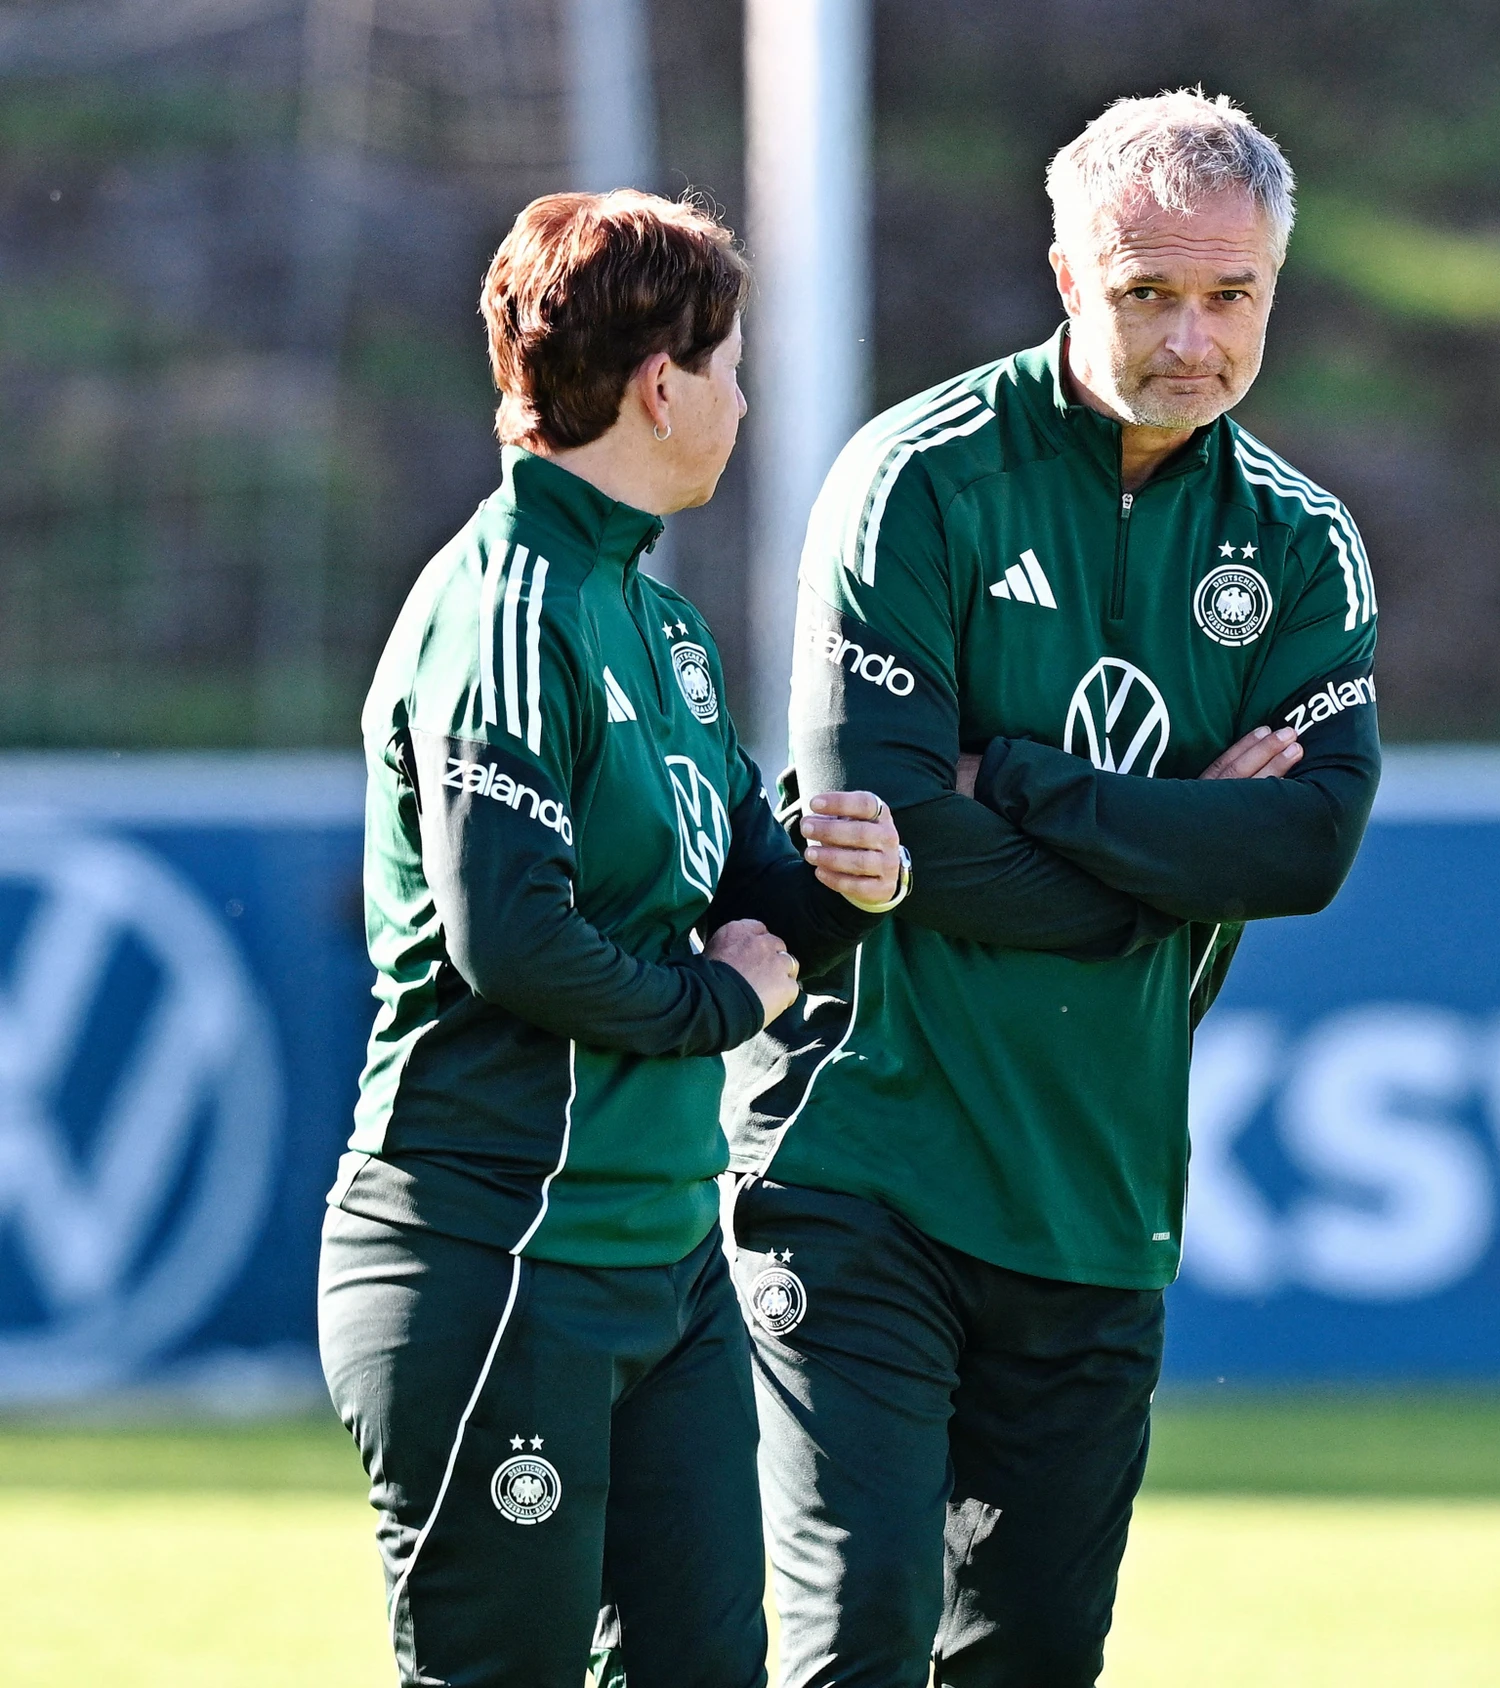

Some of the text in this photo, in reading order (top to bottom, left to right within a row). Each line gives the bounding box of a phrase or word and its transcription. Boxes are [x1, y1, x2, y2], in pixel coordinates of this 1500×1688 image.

[1212, 574, 1258, 593] DEUTSCHER
[1205, 610, 1260, 636] FUSSBALL-BUND
[442, 757, 574, 847] zalando
[507, 1464, 547, 1479] DEUTSCHER
[502, 1495, 553, 1516] FUSSBALL-BUND
